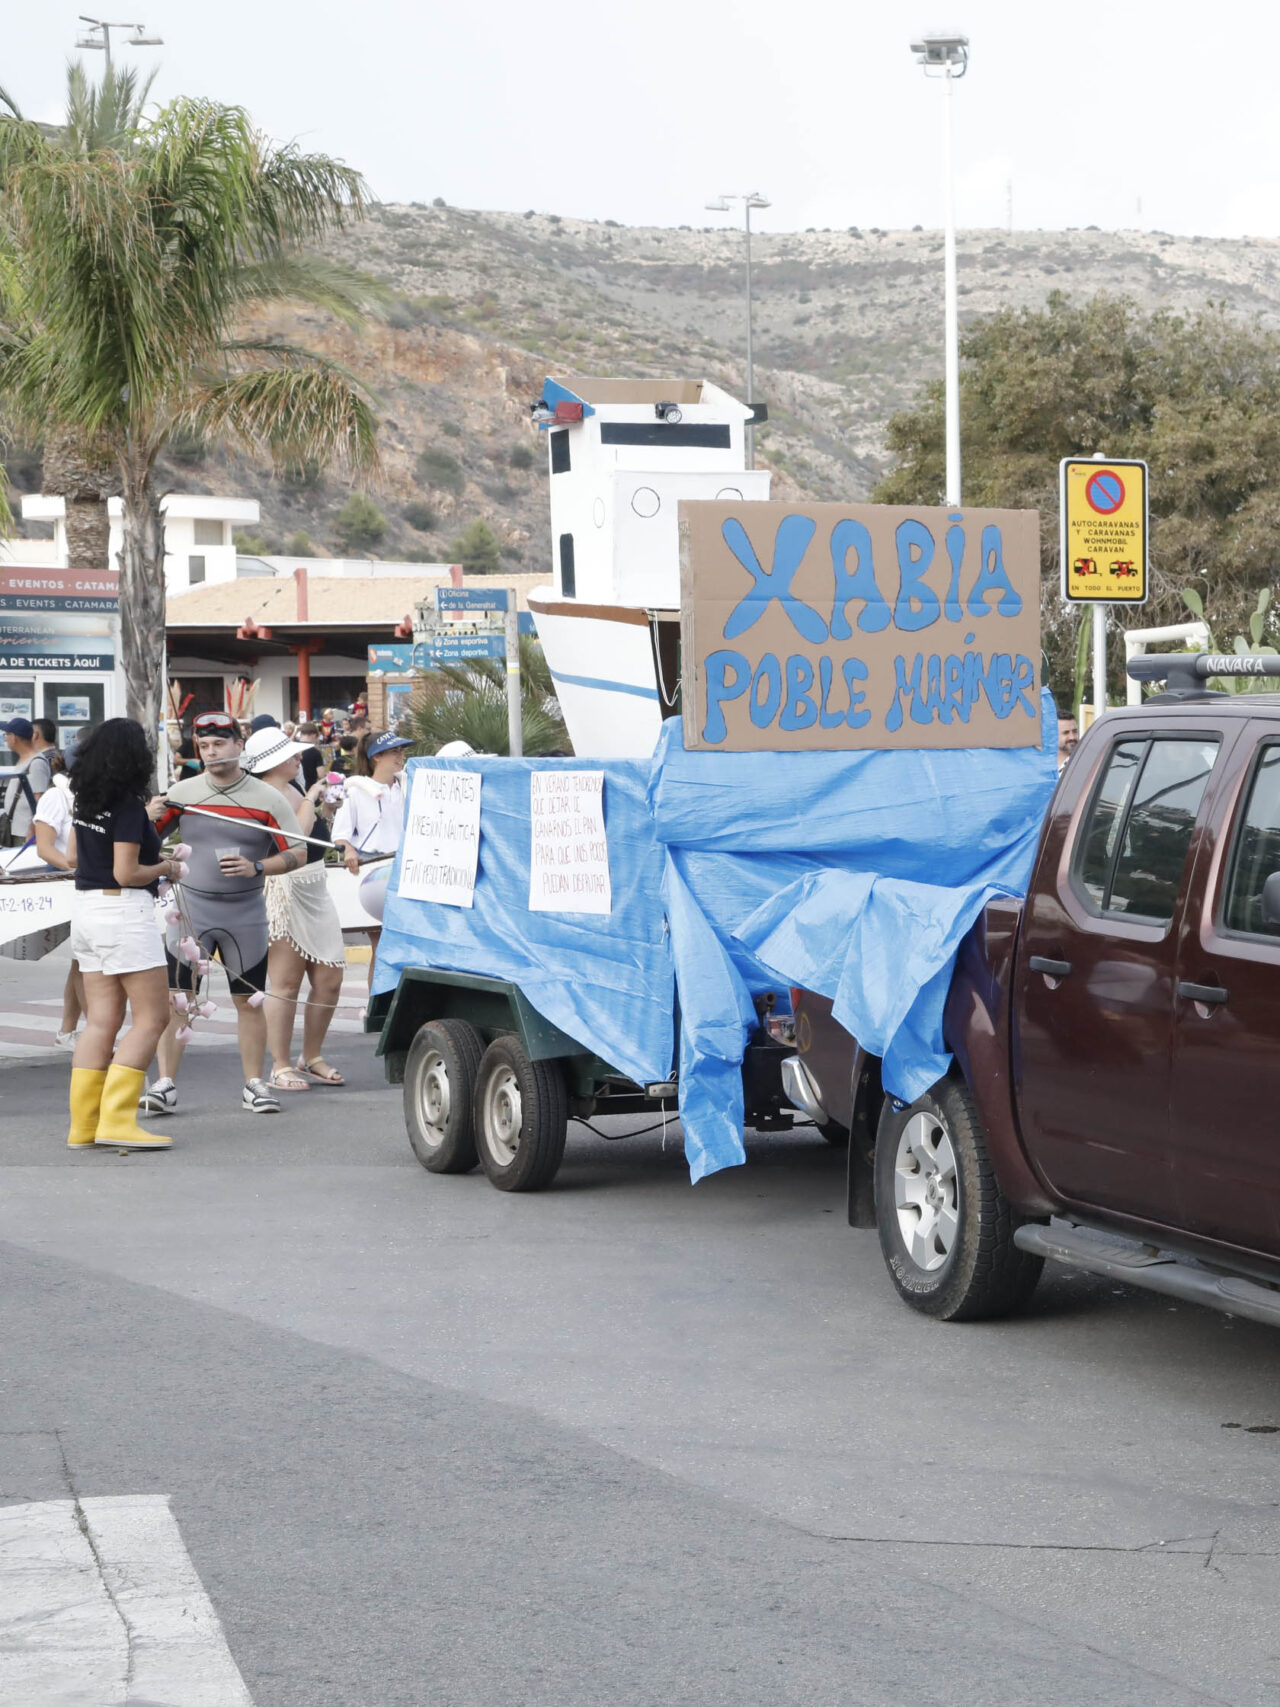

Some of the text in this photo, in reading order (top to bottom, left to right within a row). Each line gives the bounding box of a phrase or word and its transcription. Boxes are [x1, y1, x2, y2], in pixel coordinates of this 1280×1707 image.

[1072, 520, 1140, 529] AUTOCARAVANAS
[1088, 529, 1136, 537] CARAVANAS
[1083, 537, 1128, 545] WOHNMOBIL
[1087, 546, 1125, 554] CARAVAN
[9, 579, 65, 590] EVENTOS
[16, 599, 56, 609] EVENTS
[449, 601, 456, 609] de
[443, 638, 489, 648] Zona esportiva
[443, 649, 489, 659] Zona deportiva
[10, 658, 25, 667] DE
[27, 658, 71, 668] TICKETS
[1206, 657, 1267, 673] NAVARA
[702, 649, 872, 744] POBLE
